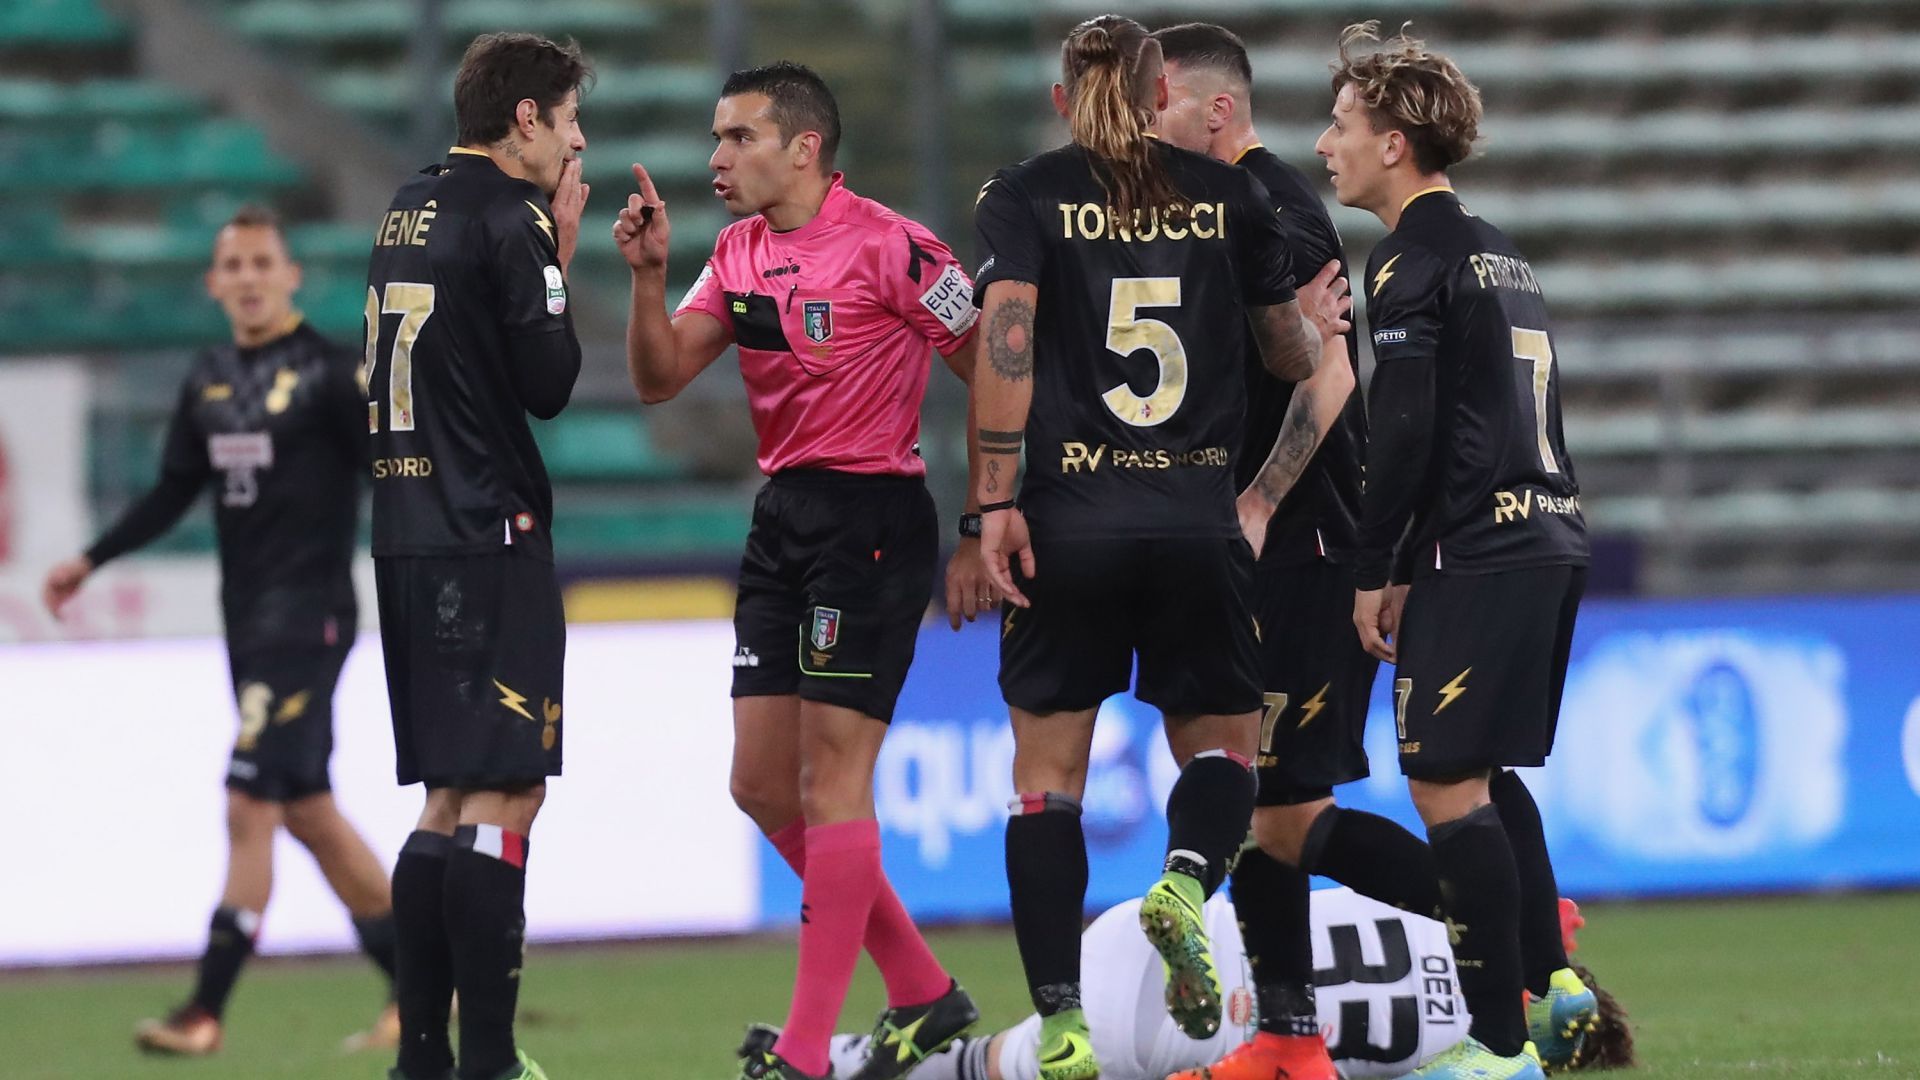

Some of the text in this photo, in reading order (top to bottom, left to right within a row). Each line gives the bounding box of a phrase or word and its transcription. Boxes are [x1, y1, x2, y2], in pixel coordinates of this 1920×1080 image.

[1058, 202, 1225, 242] TONUCCI
[925, 269, 961, 311] EURO
[939, 288, 973, 321] VIT
[1101, 276, 1188, 427] 5
[1511, 325, 1560, 473] 7
